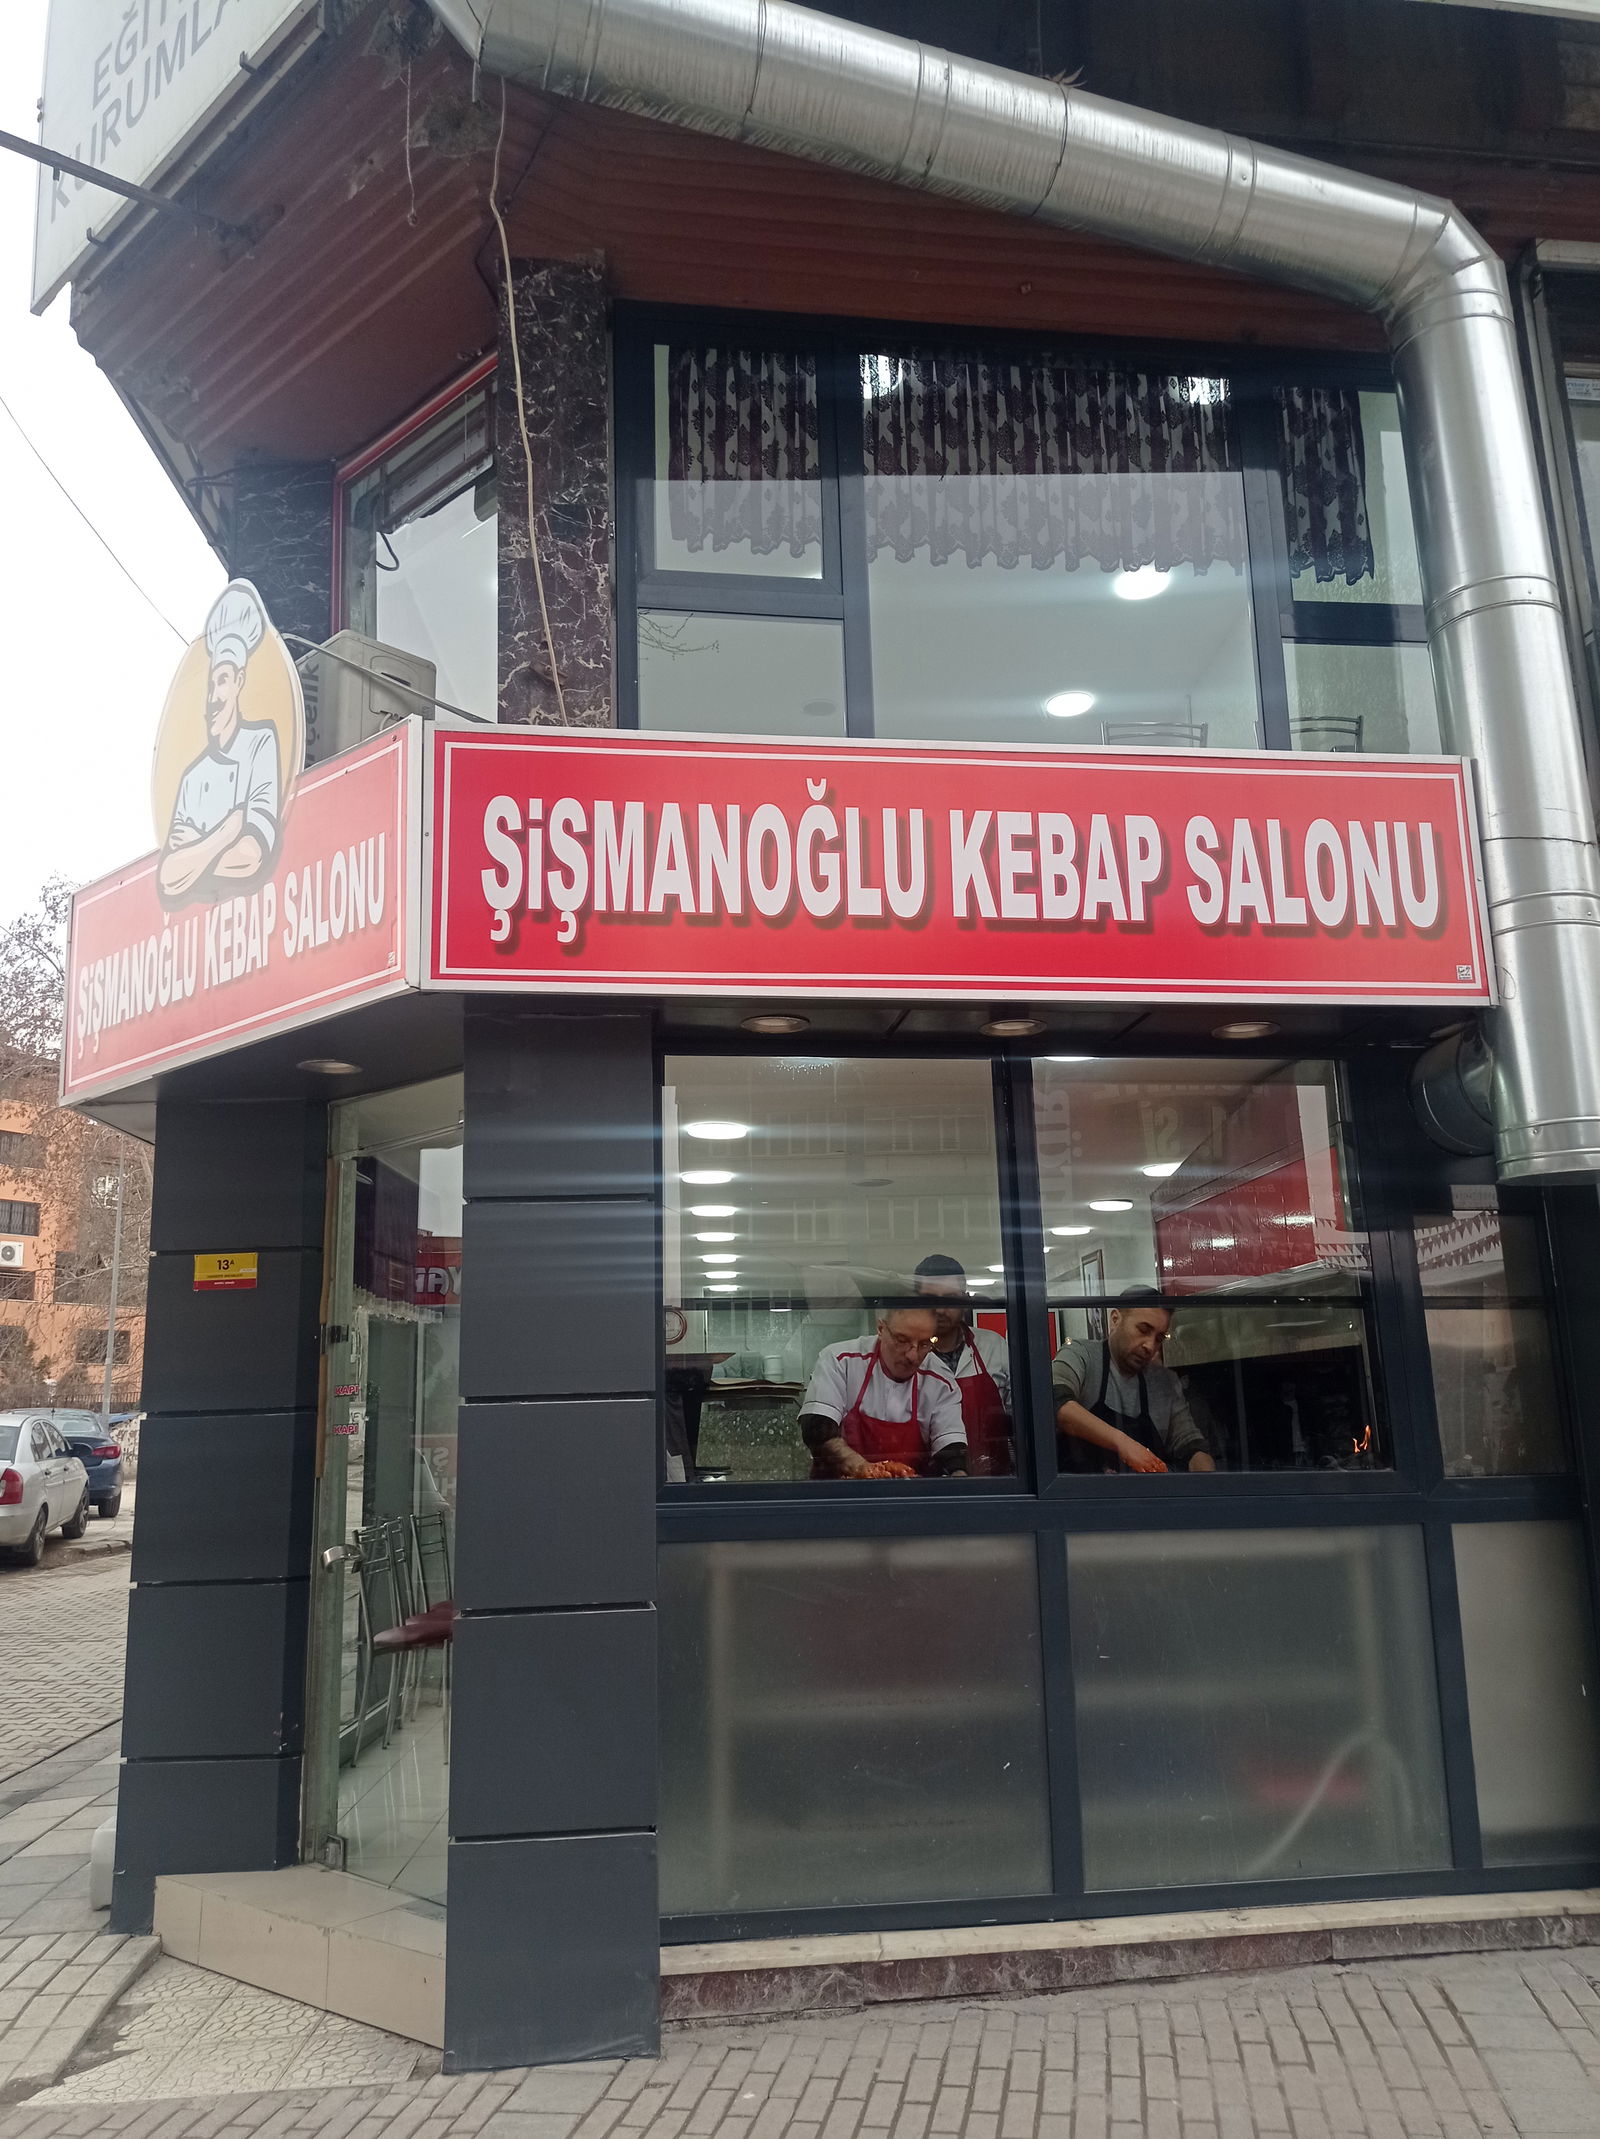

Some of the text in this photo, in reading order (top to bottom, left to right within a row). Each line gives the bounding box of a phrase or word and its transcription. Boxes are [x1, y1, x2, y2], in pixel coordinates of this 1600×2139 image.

[204, 882, 277, 989] KEBAP
[283, 832, 385, 957] SALONU
[481, 779, 1440, 945] ŞİŞMANOĞLU KEBAP SALONU
[333, 1424, 359, 1435] KAPI
